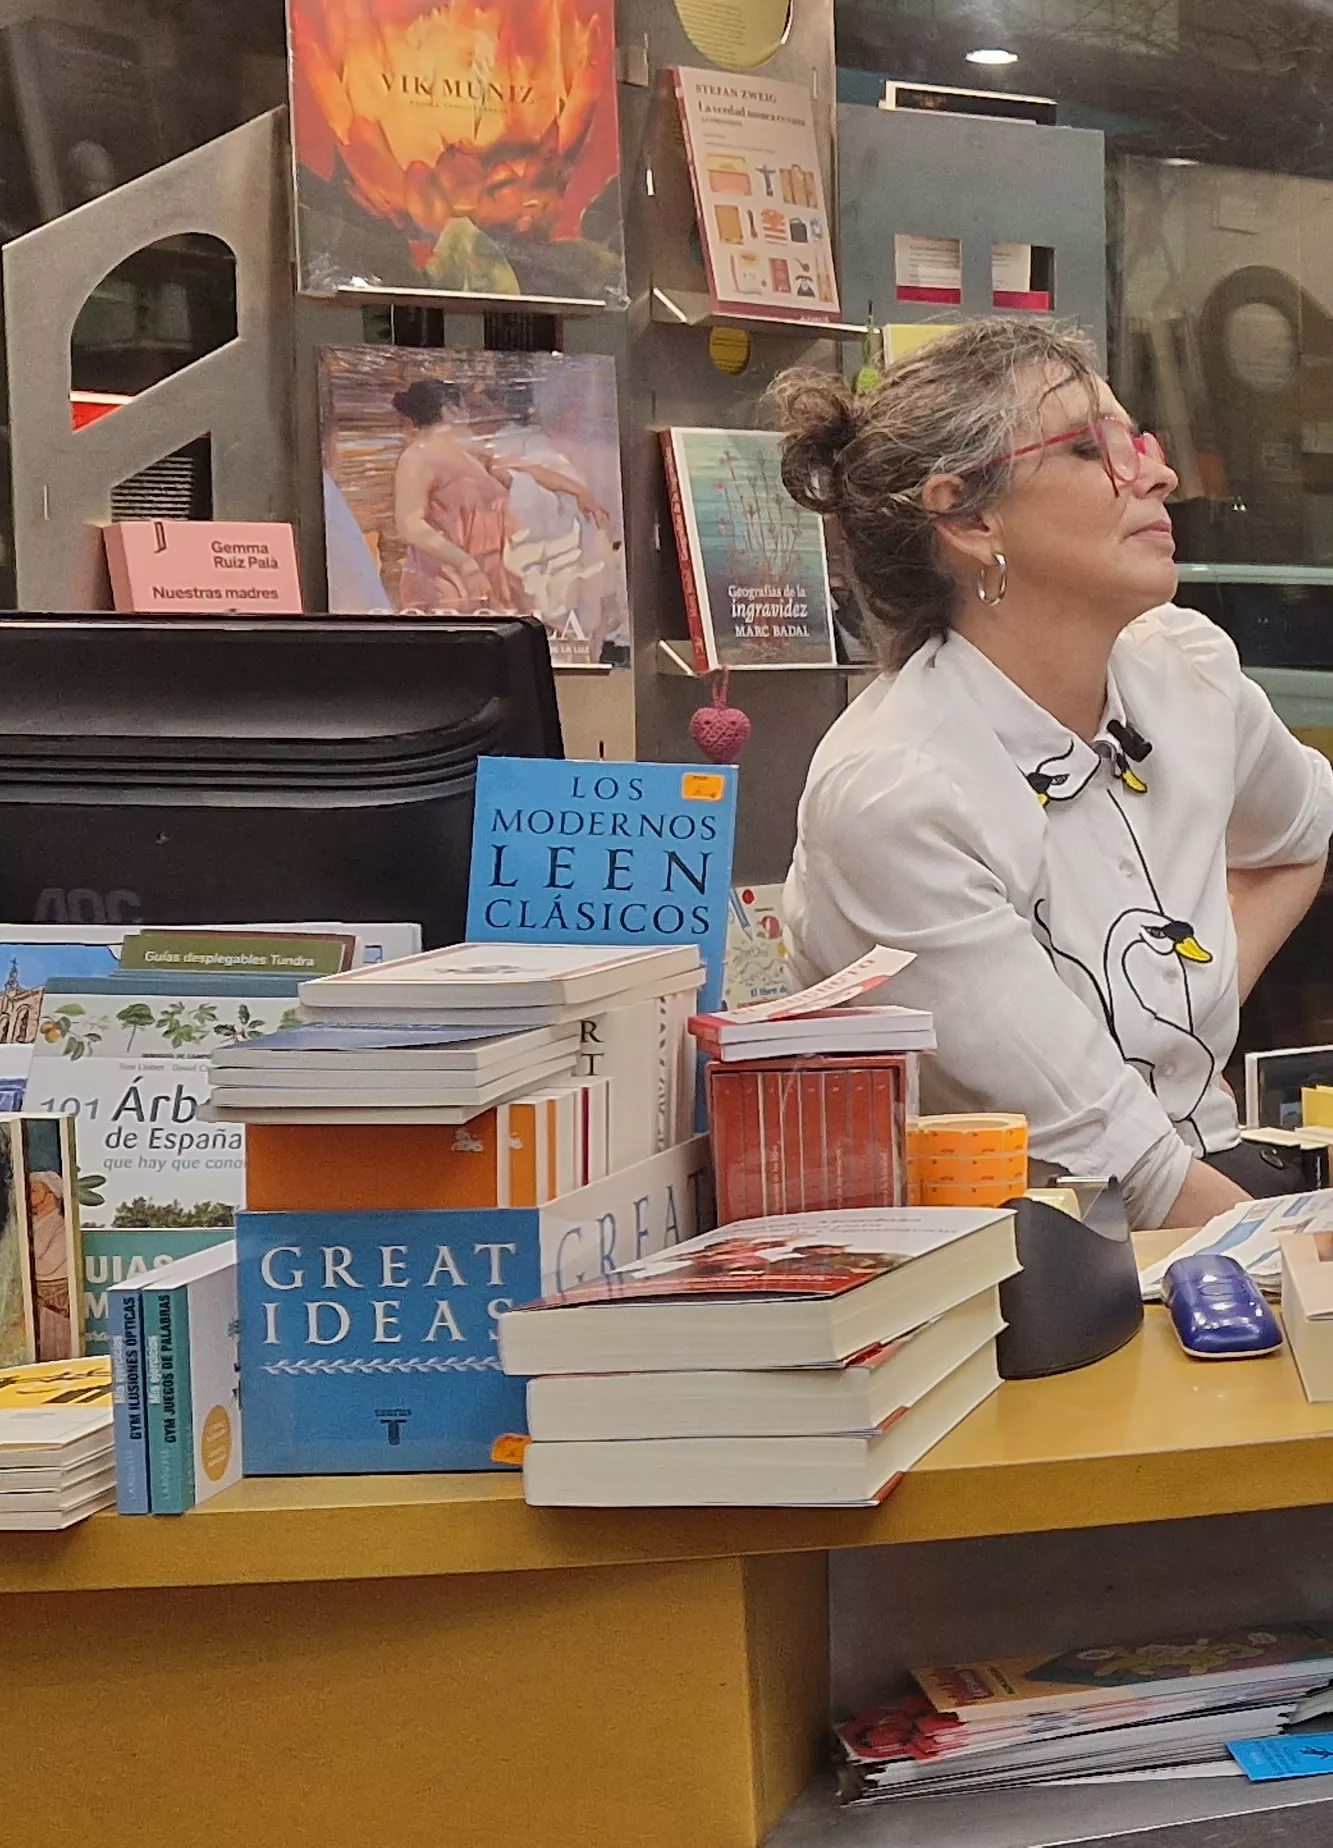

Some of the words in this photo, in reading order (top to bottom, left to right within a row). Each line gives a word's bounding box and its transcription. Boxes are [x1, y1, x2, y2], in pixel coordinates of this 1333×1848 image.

[381, 73, 437, 96] VIK
[696, 83, 738, 97] STEFAN
[742, 90, 777, 103] ZWEIG
[211, 541, 269, 555] Gemma
[215, 556, 245, 569] Ruiz
[152, 585, 222, 600] Nuestras
[226, 587, 279, 600] madres
[728, 585, 781, 603] Geografías
[784, 584, 797, 597] de
[798, 583, 806, 597] la
[731, 600, 808, 623] ingravidez
[735, 625, 769, 637] MARC
[772, 625, 809, 637] BADAL
[571, 776, 644, 801] LOS
[492, 809, 716, 841] MODERNOS
[488, 845, 713, 895] LEEN
[485, 893, 711, 935] CLÁSICOS
[144, 949, 180, 963] Guías
[184, 951, 266, 966] desplegables
[270, 953, 315, 967] Tundra
[105, 1126, 138, 1149] de
[149, 1127, 242, 1156] España
[103, 1158, 132, 1172] que
[138, 1155, 166, 1172] hay
[172, 1158, 200, 1172] que
[261, 1243, 516, 1291] GREAT
[159, 1295, 173, 1351] PALABRAS
[162, 1355, 173, 1369] DE
[126, 1350, 140, 1410] ILUSIONES
[162, 1373, 176, 1415] JUEGOS
[130, 1414, 142, 1439] GYM
[164, 1419, 177, 1443] GYM
